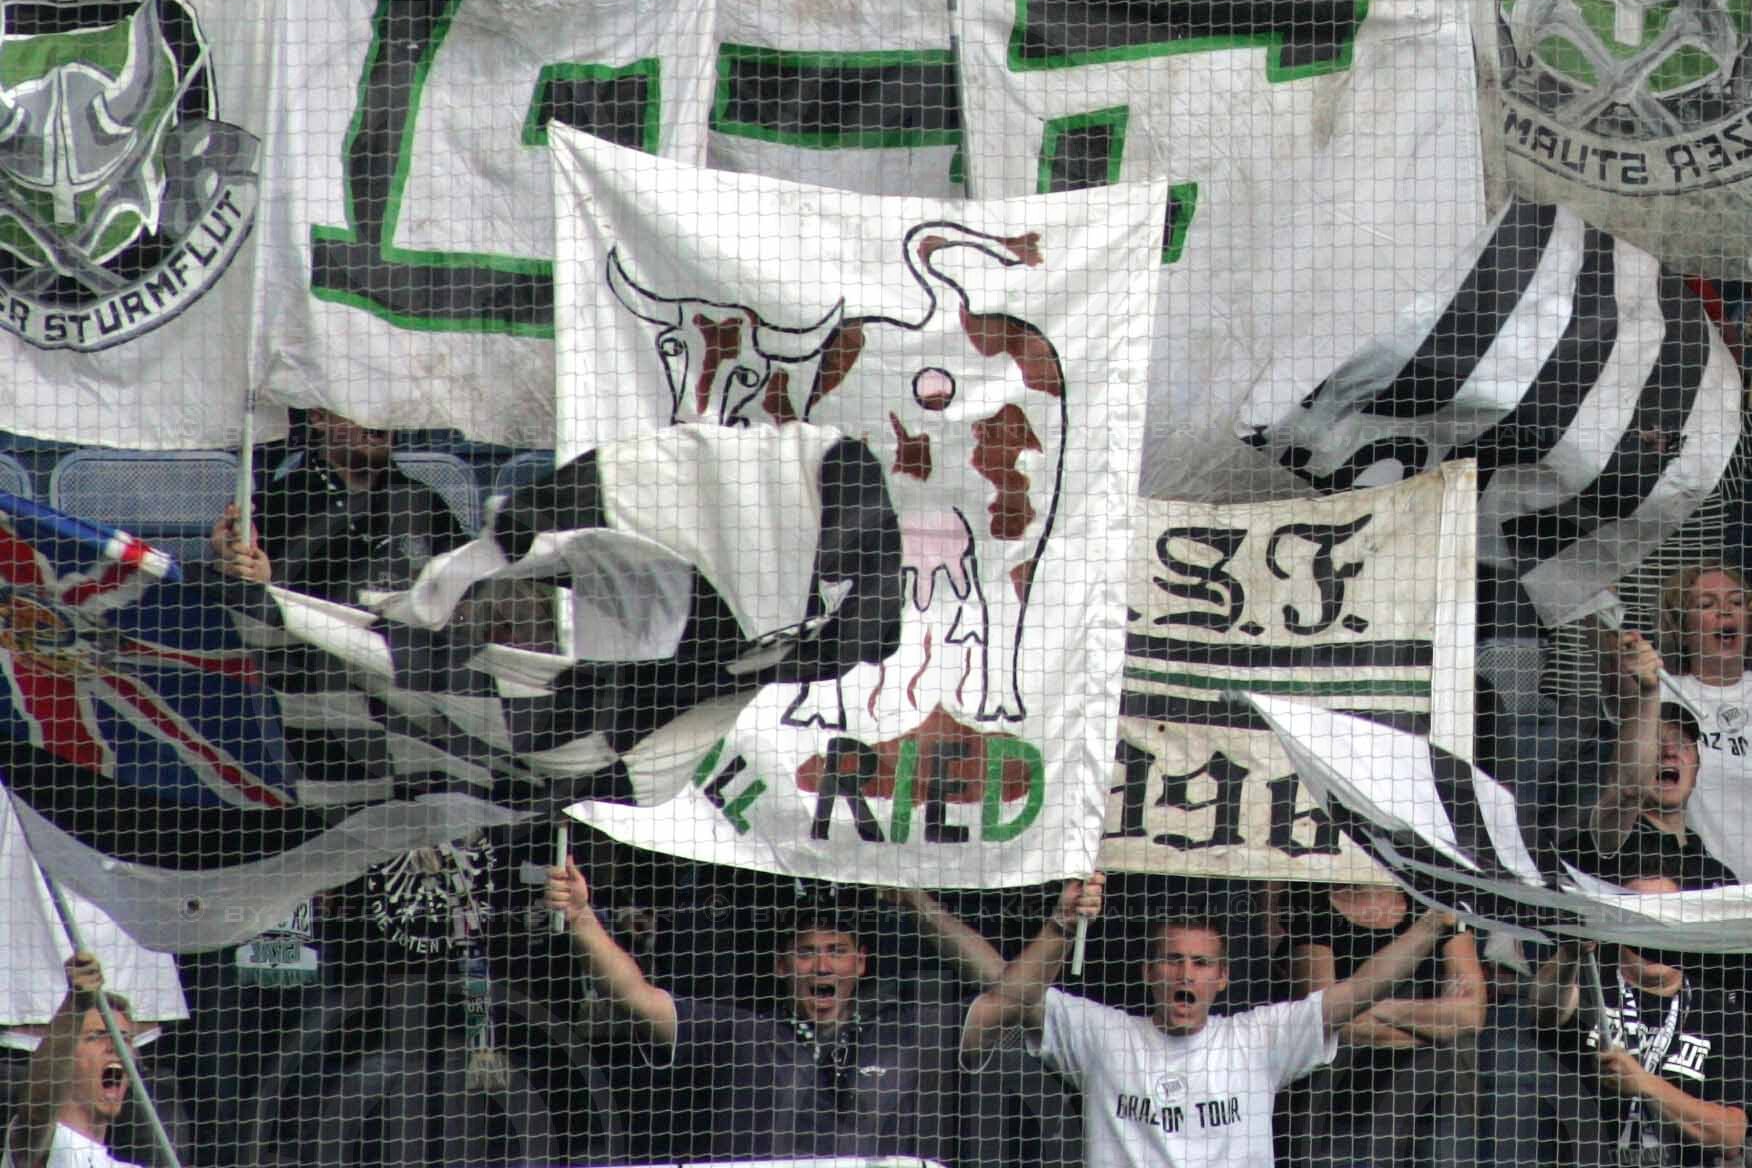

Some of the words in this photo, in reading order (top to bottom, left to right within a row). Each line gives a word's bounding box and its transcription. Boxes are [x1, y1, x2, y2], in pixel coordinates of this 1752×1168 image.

[44, 190, 242, 343] STURMFLUT
[809, 736, 1046, 844] RIED
[1195, 1096, 1241, 1129] TOUR
